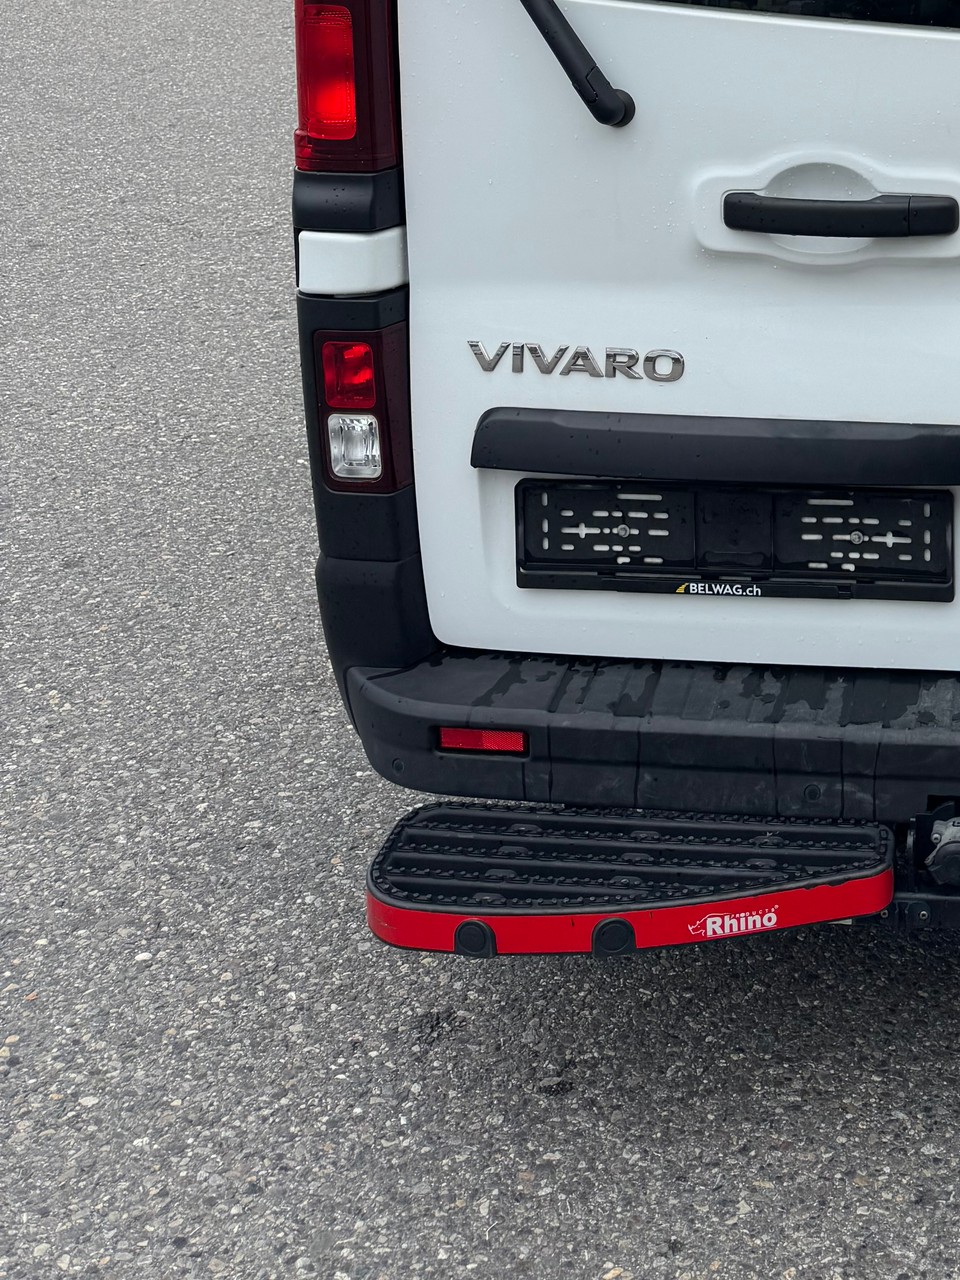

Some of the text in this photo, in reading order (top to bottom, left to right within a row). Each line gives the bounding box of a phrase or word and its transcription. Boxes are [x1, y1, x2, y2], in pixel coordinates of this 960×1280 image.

[467, 339, 685, 383] VIVARO
[689, 582, 762, 597] BELWAG.ch
[706, 912, 777, 937] Rhino
